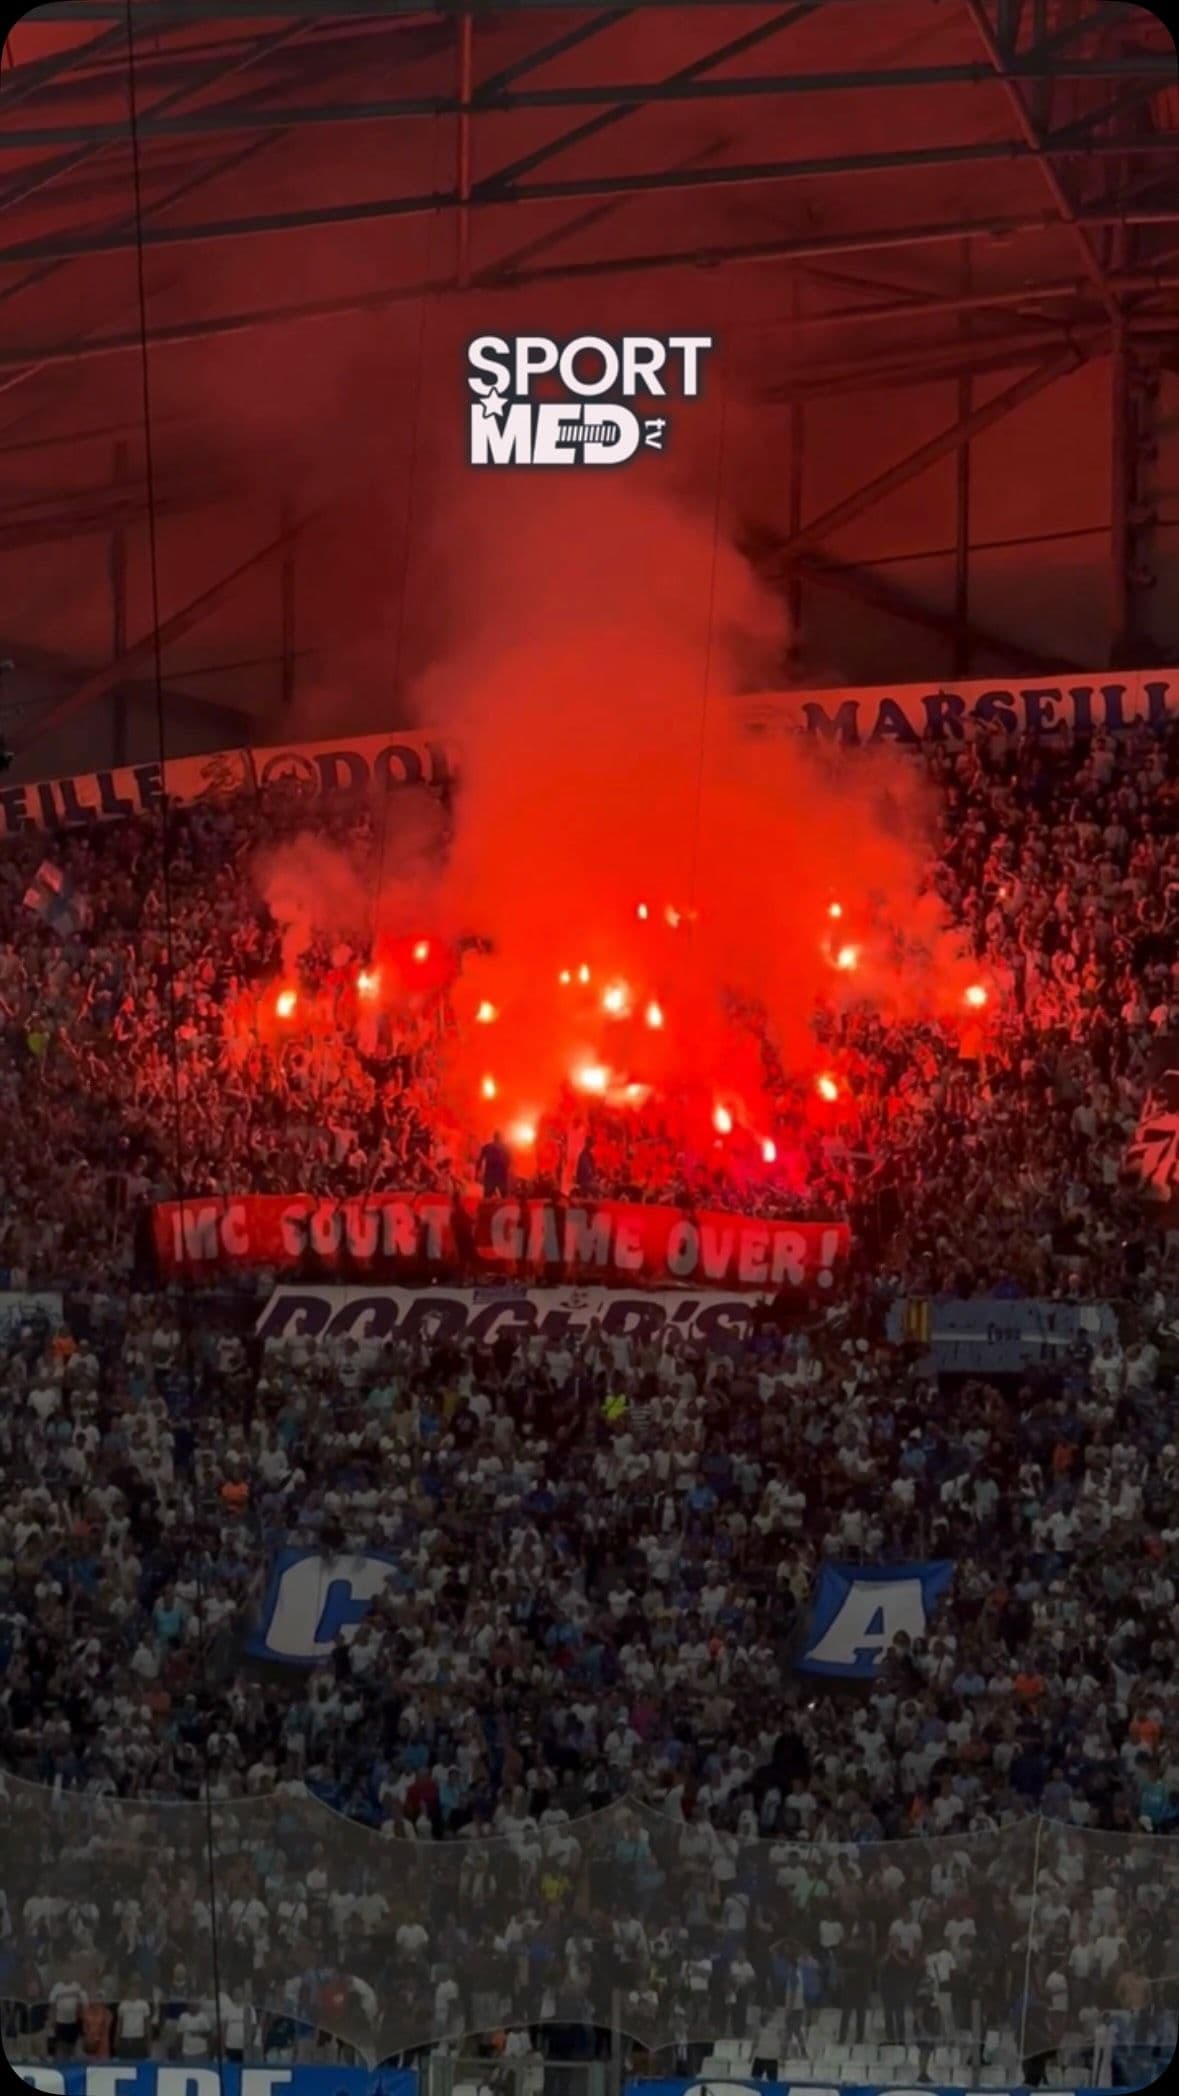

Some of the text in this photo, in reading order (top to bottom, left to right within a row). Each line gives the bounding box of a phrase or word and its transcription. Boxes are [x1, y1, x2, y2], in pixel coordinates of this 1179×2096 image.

[282, 1201, 453, 1259] COURT
[490, 1203, 645, 1269] GAME
[667, 1220, 840, 1289] OVER!
[804, 1578, 926, 1664] A
